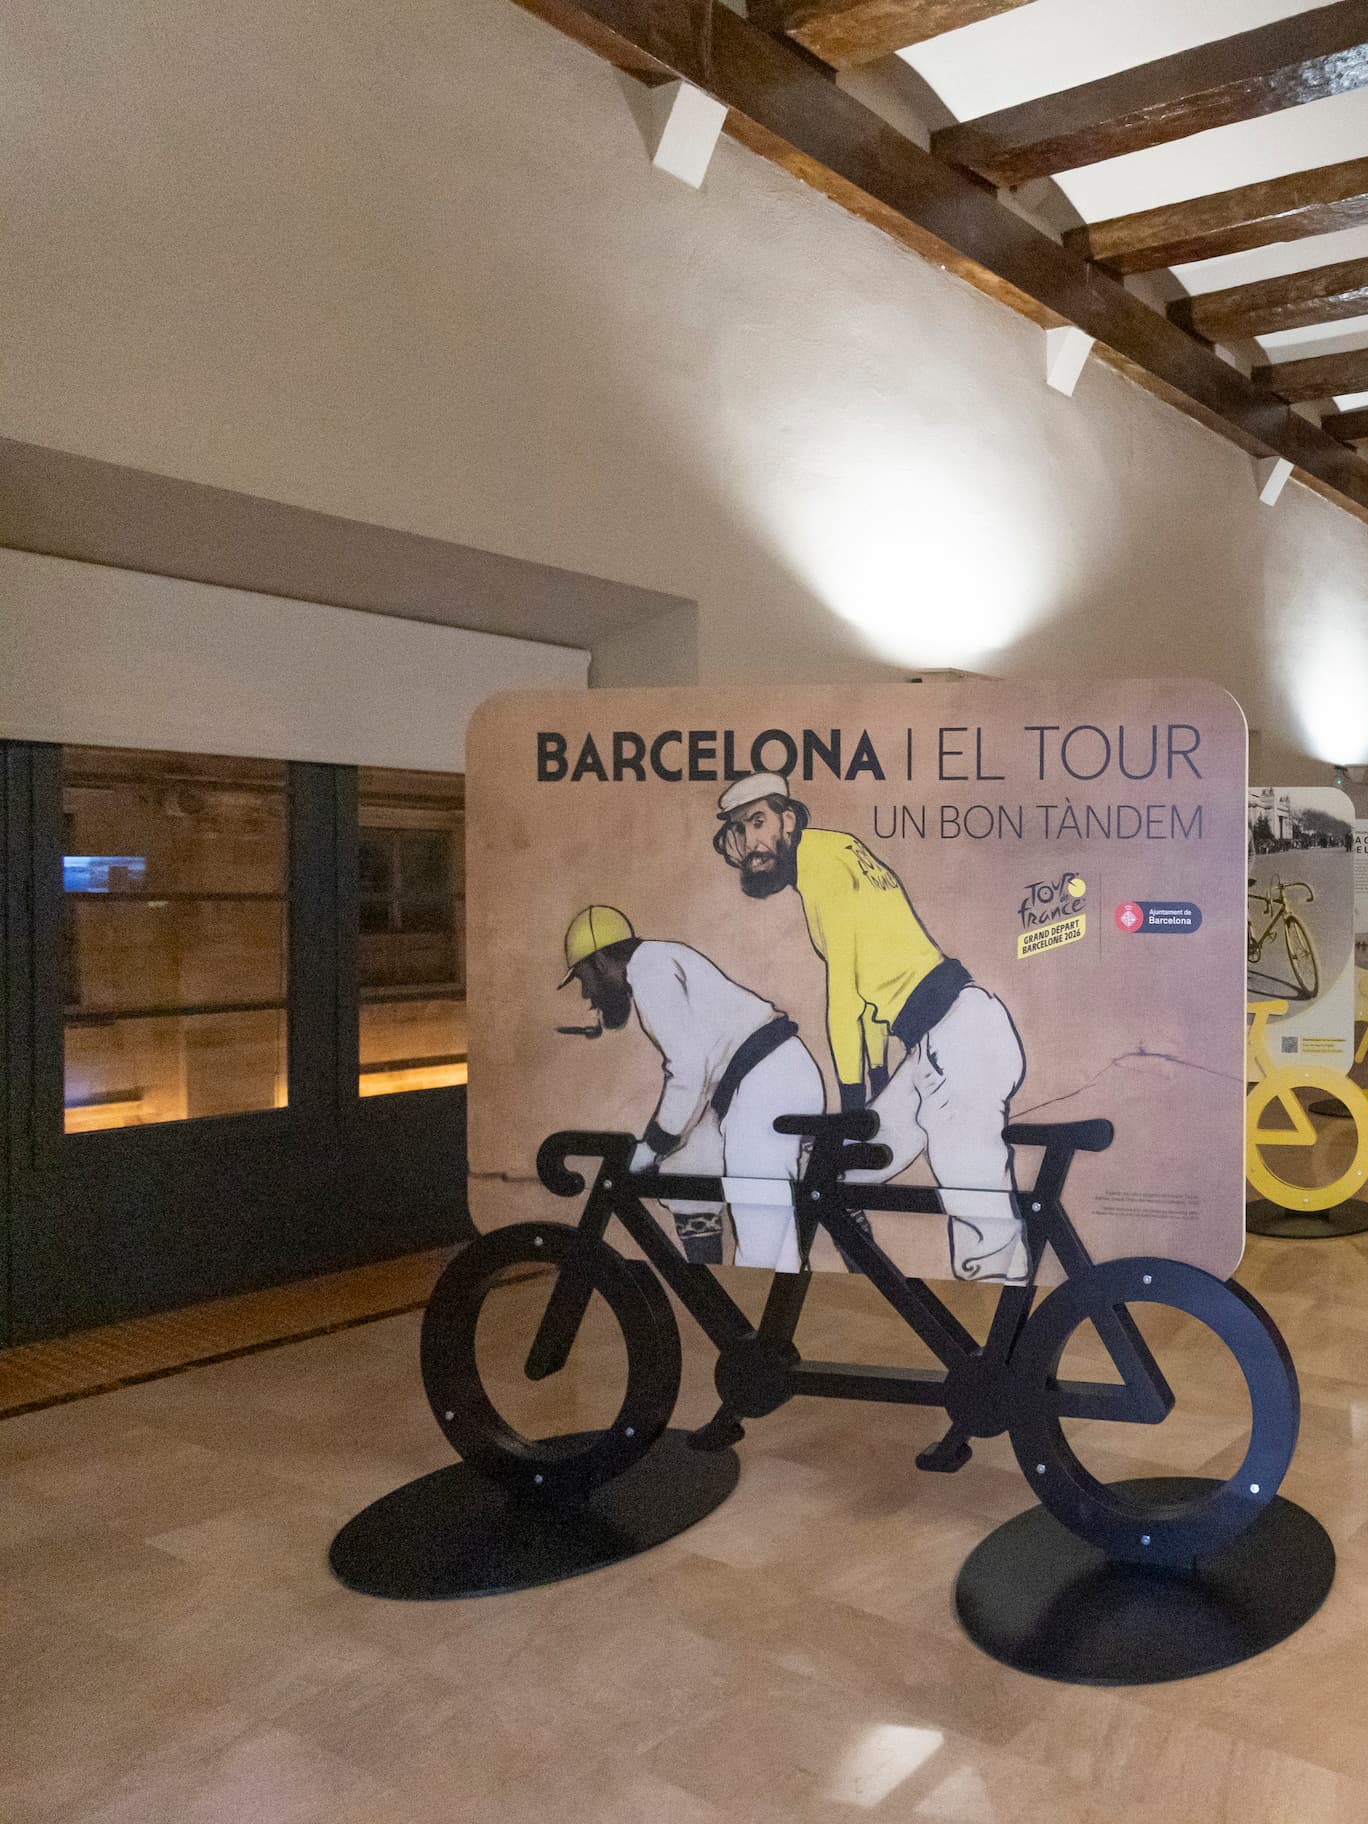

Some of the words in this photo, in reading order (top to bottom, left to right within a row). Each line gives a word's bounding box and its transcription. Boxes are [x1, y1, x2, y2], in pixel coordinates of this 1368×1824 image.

[536, 728, 886, 782] BARCELONA
[938, 726, 1005, 781] EL
[1023, 724, 1202, 781] TOUR
[873, 804, 926, 839] UN
[940, 804, 1023, 839] BON
[1035, 796, 1203, 840] TÀNDEM
[1148, 916, 1192, 925] Barcelona
[1149, 908, 1183, 916] Ajuntament
[1022, 933, 1063, 955] BARCELONE
[1064, 927, 1081, 941] 2026
[1023, 929, 1050, 945] GRAND
